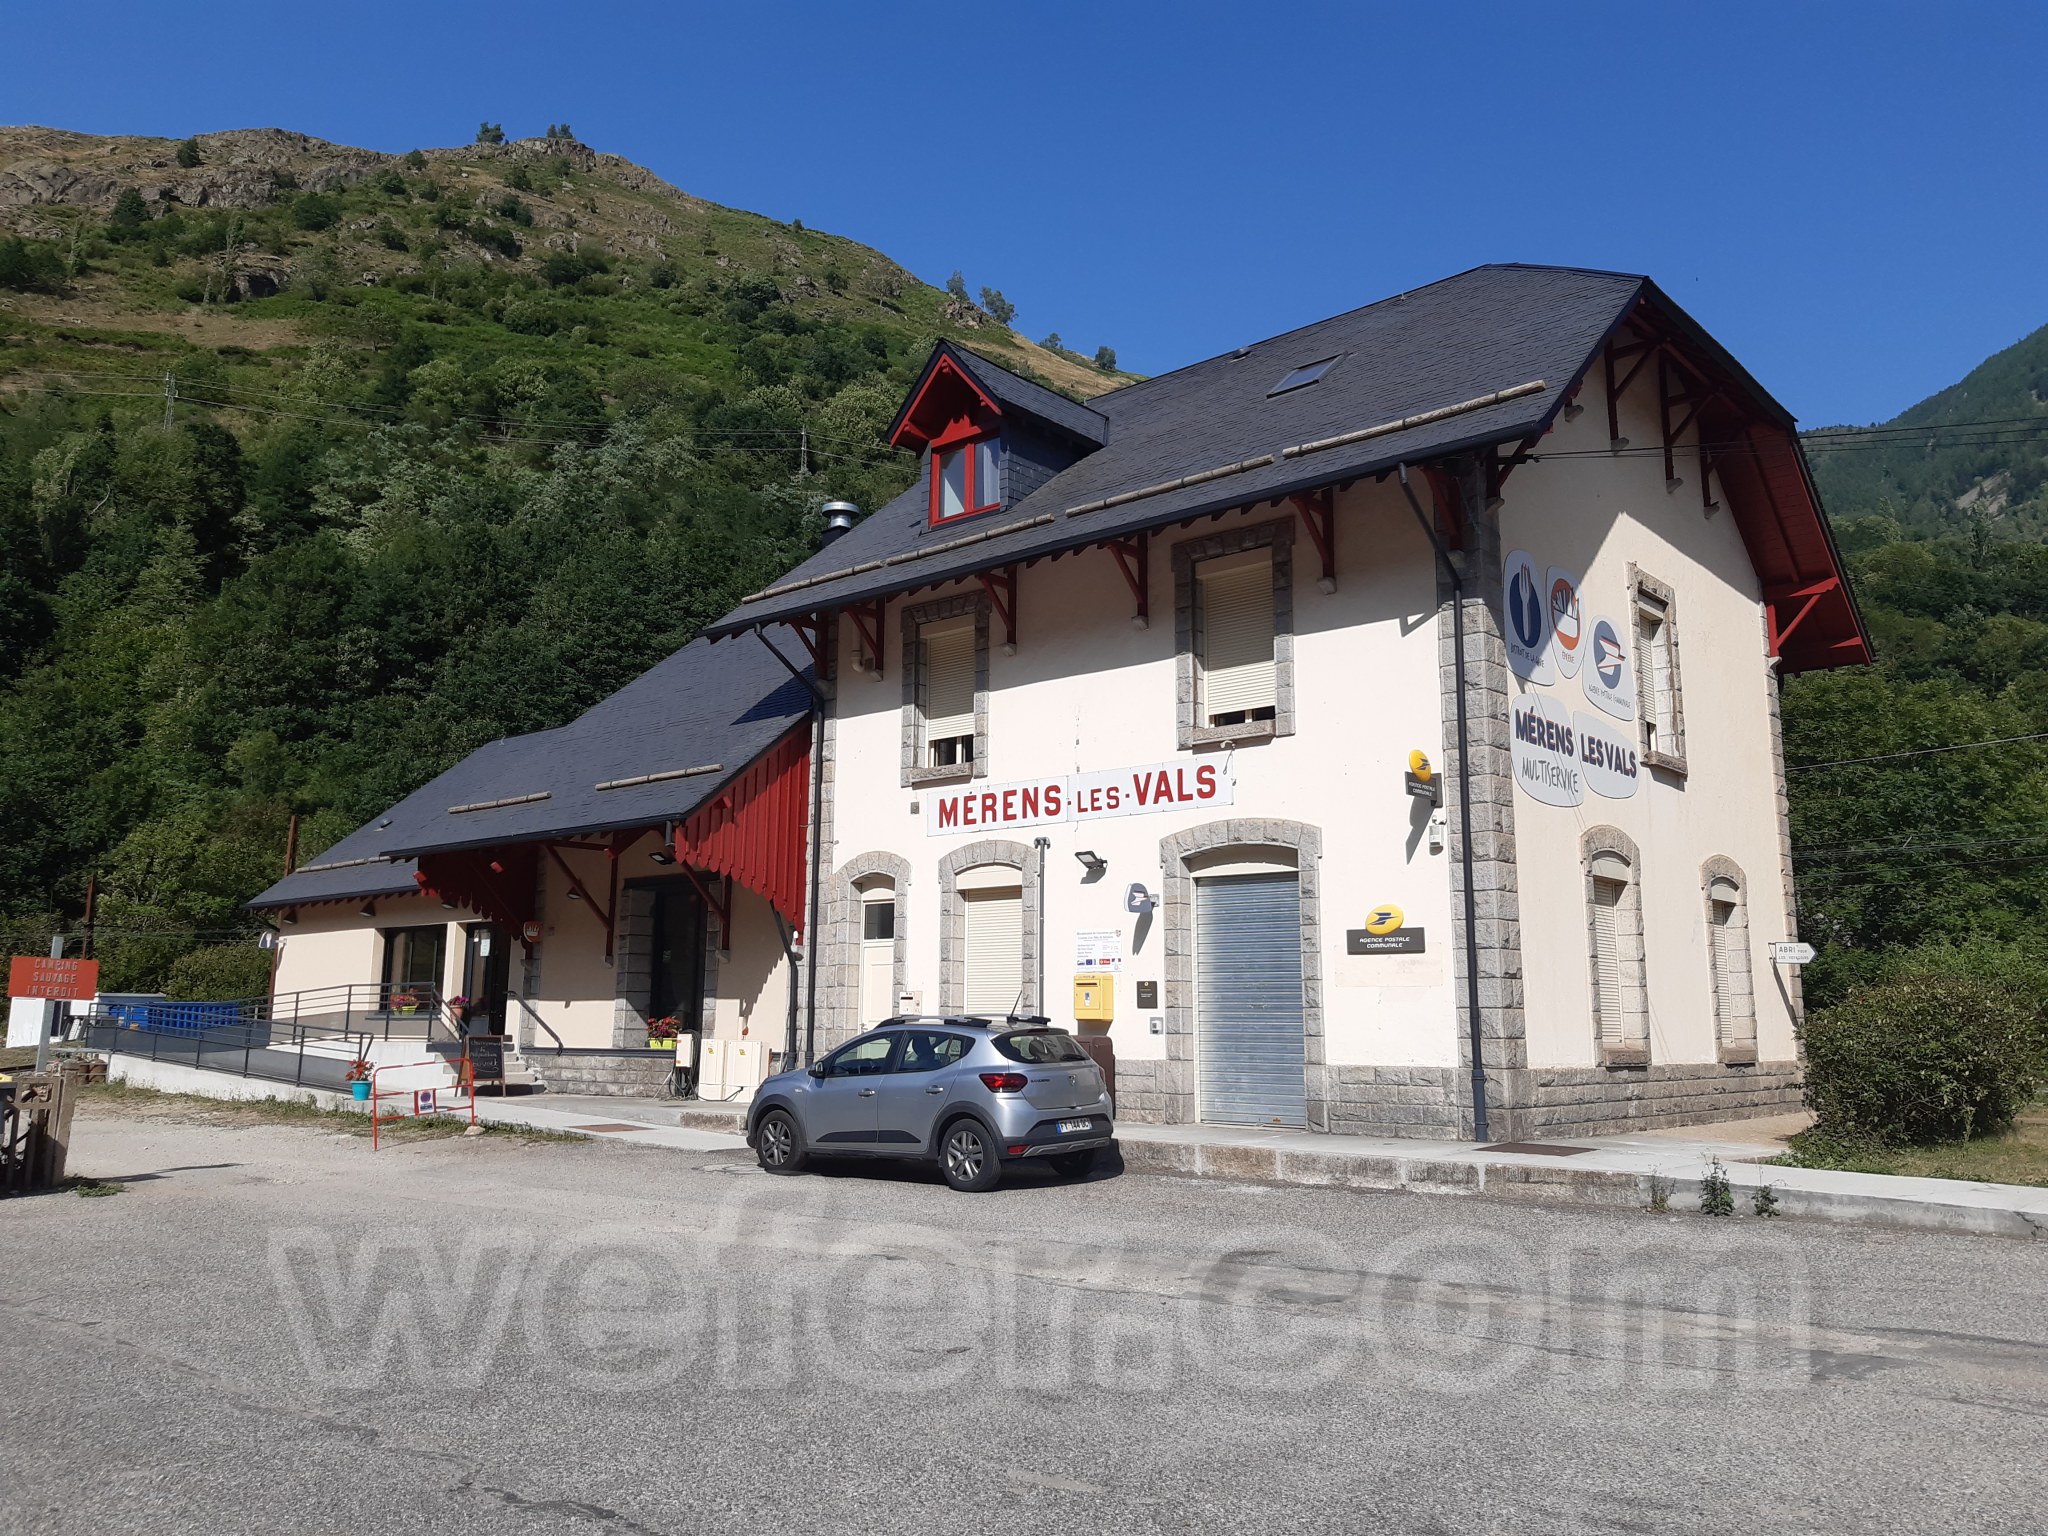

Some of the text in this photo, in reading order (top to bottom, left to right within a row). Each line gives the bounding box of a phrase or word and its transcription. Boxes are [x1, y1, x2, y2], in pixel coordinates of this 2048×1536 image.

[1515, 705, 1575, 757] MÉRENS
[1521, 756, 1579, 796] MULTISERVICE
[34, 958, 79, 971] CAMPING
[33, 971, 77, 984] SAUVAGE
[26, 985, 79, 998] INTERDIT
